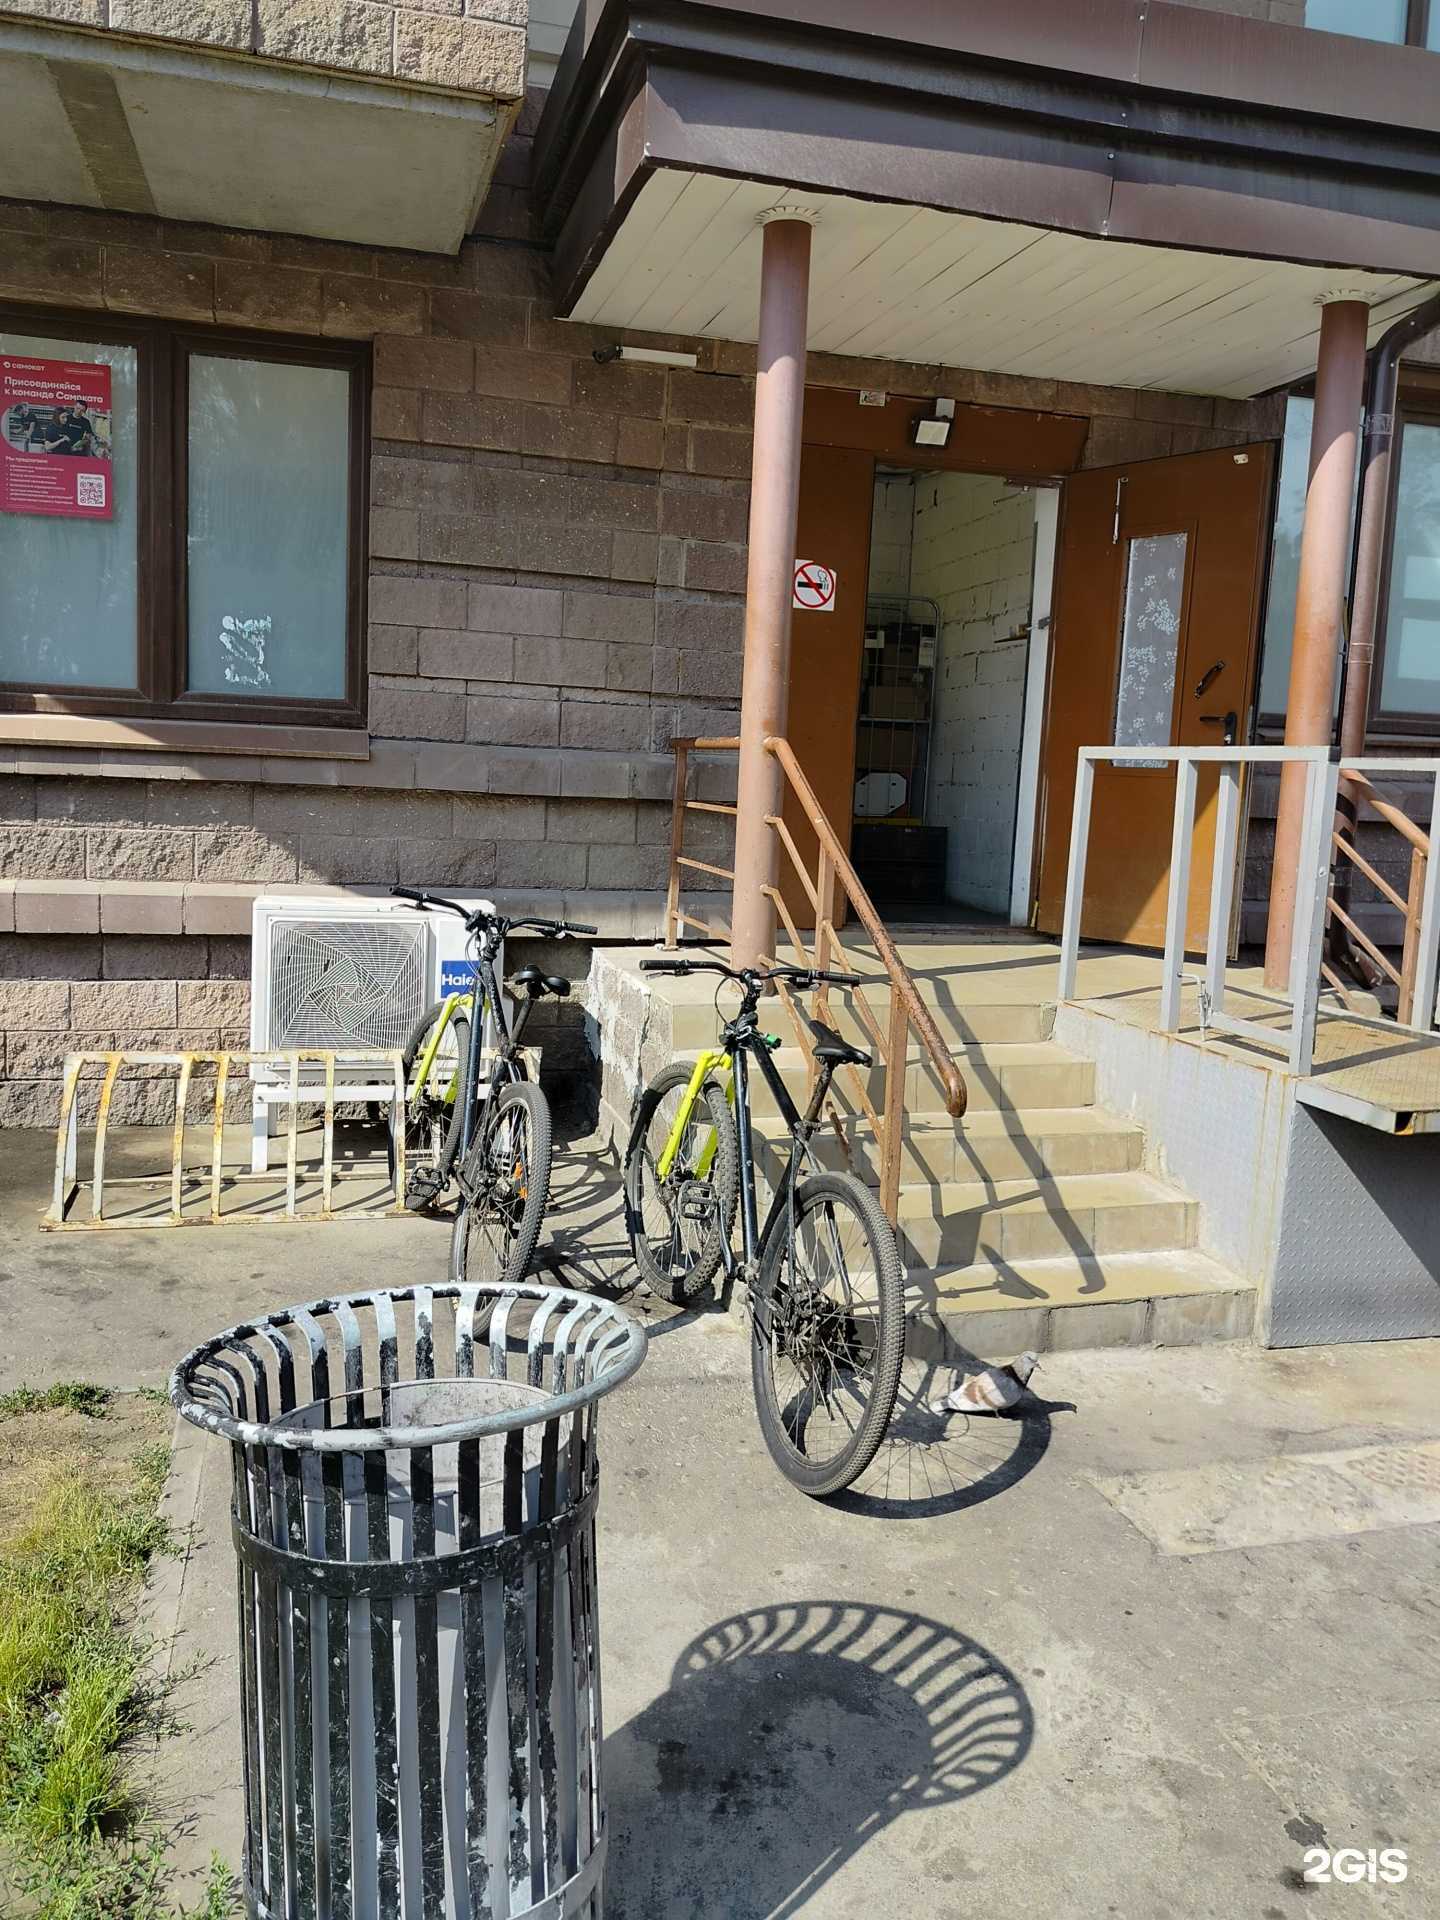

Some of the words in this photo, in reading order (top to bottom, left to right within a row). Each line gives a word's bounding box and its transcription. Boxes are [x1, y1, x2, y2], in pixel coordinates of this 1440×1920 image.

[4, 376, 81, 391] Присоединяйся
[13, 389, 54, 400] команде
[56, 391, 103, 403] Самоката
[442, 973, 475, 986] Haie
